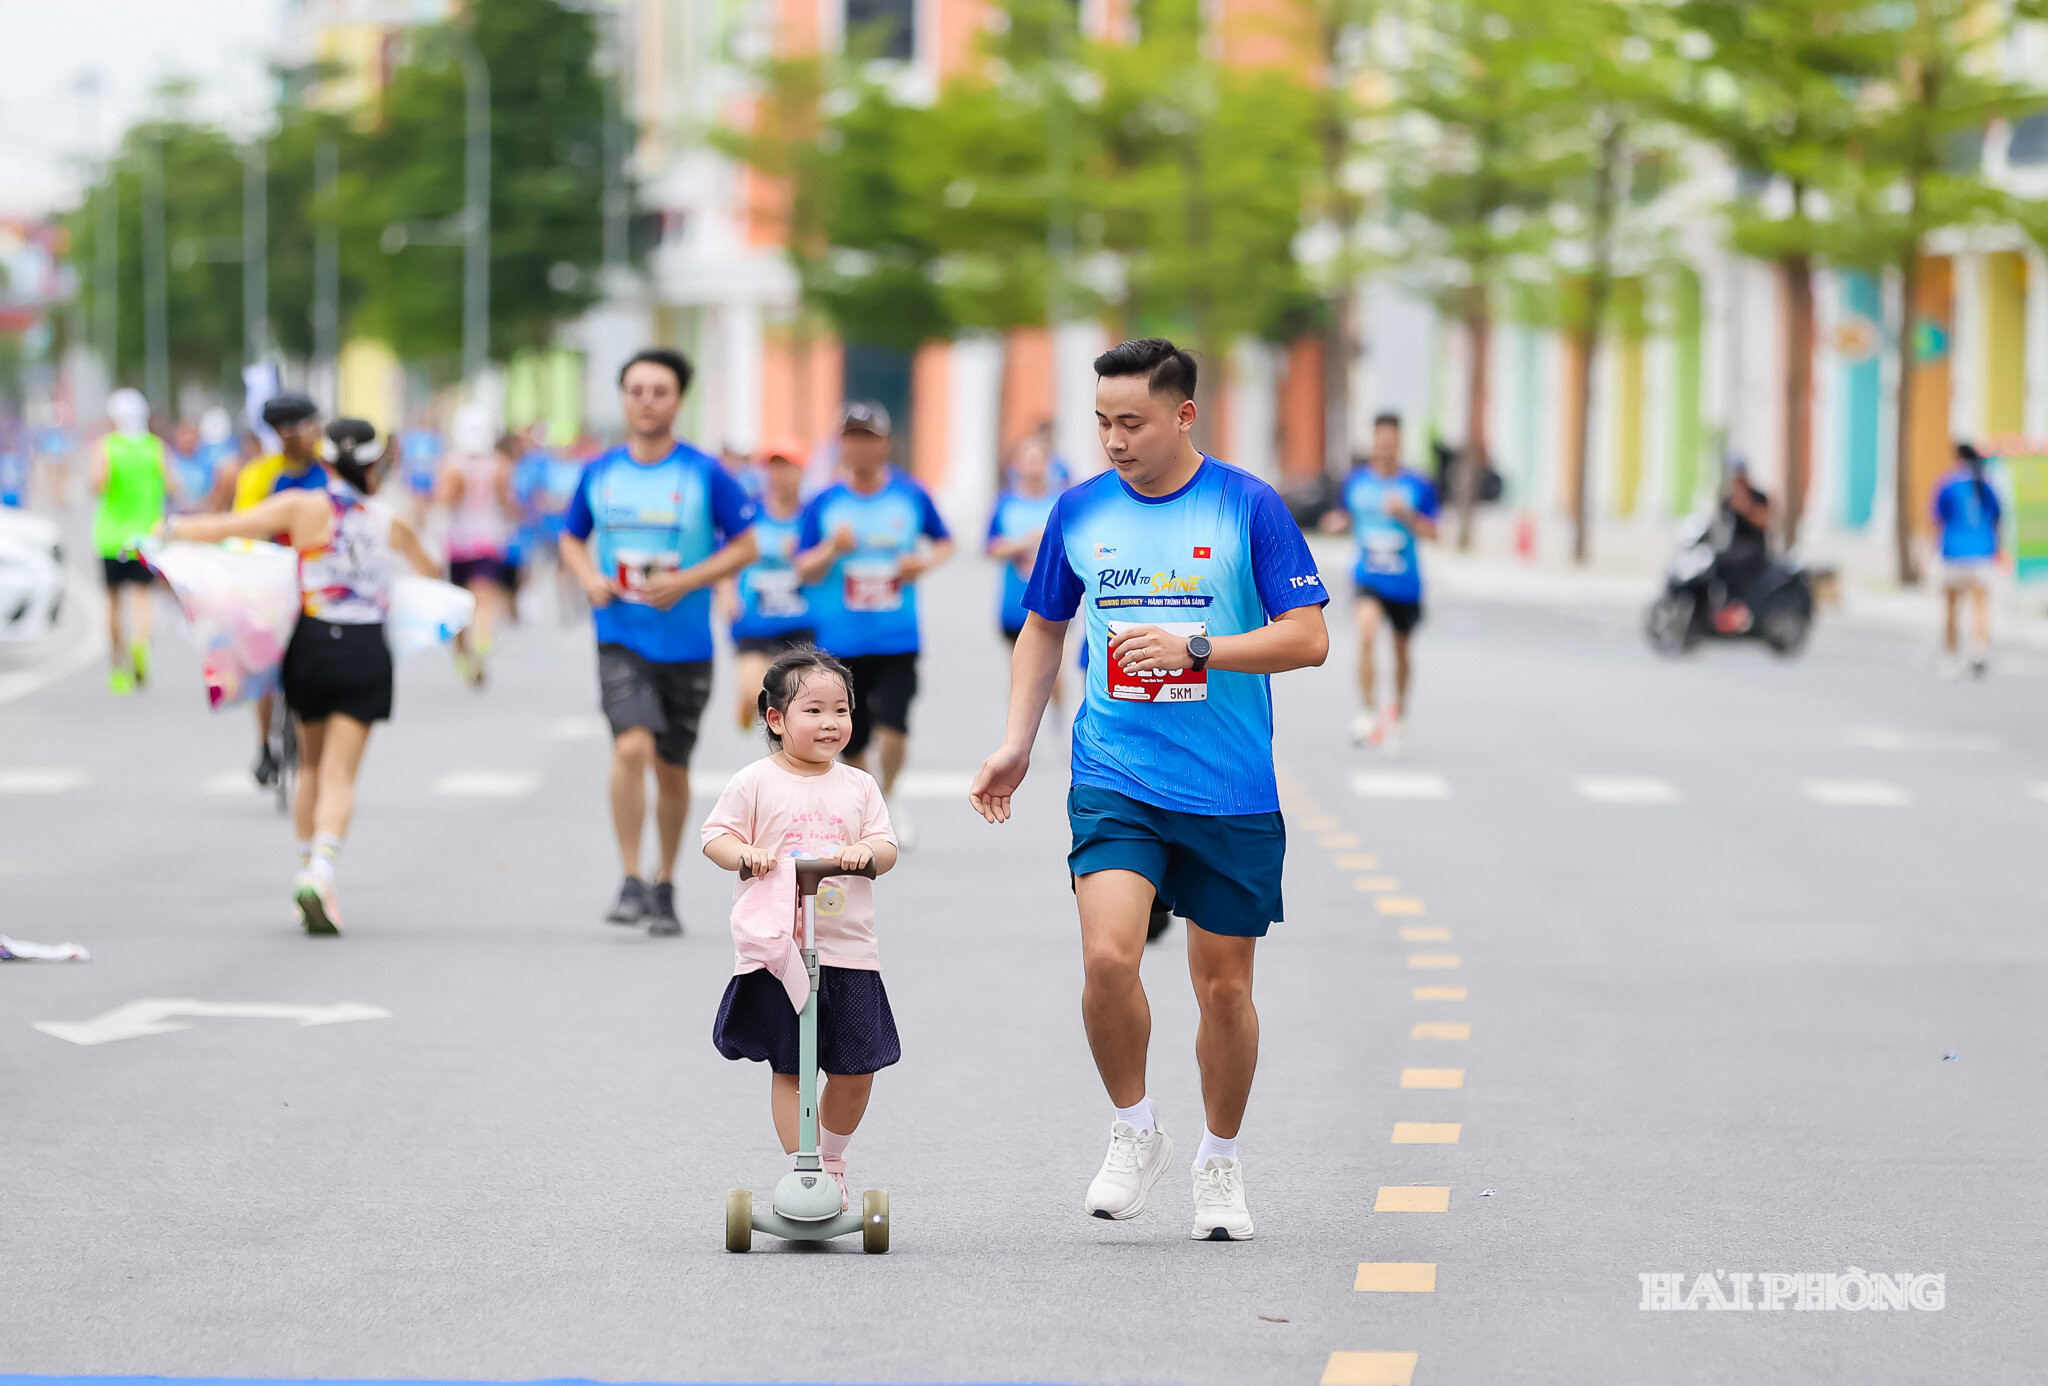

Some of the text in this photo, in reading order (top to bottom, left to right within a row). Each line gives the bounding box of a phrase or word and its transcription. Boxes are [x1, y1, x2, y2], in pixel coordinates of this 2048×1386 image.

[1097, 568, 1204, 594] RUN TO SHINE
[1120, 598, 1143, 607] JOURNEY
[1170, 688, 1192, 699] 5KM
[829, 815, 843, 825] go
[785, 832, 802, 841] my
